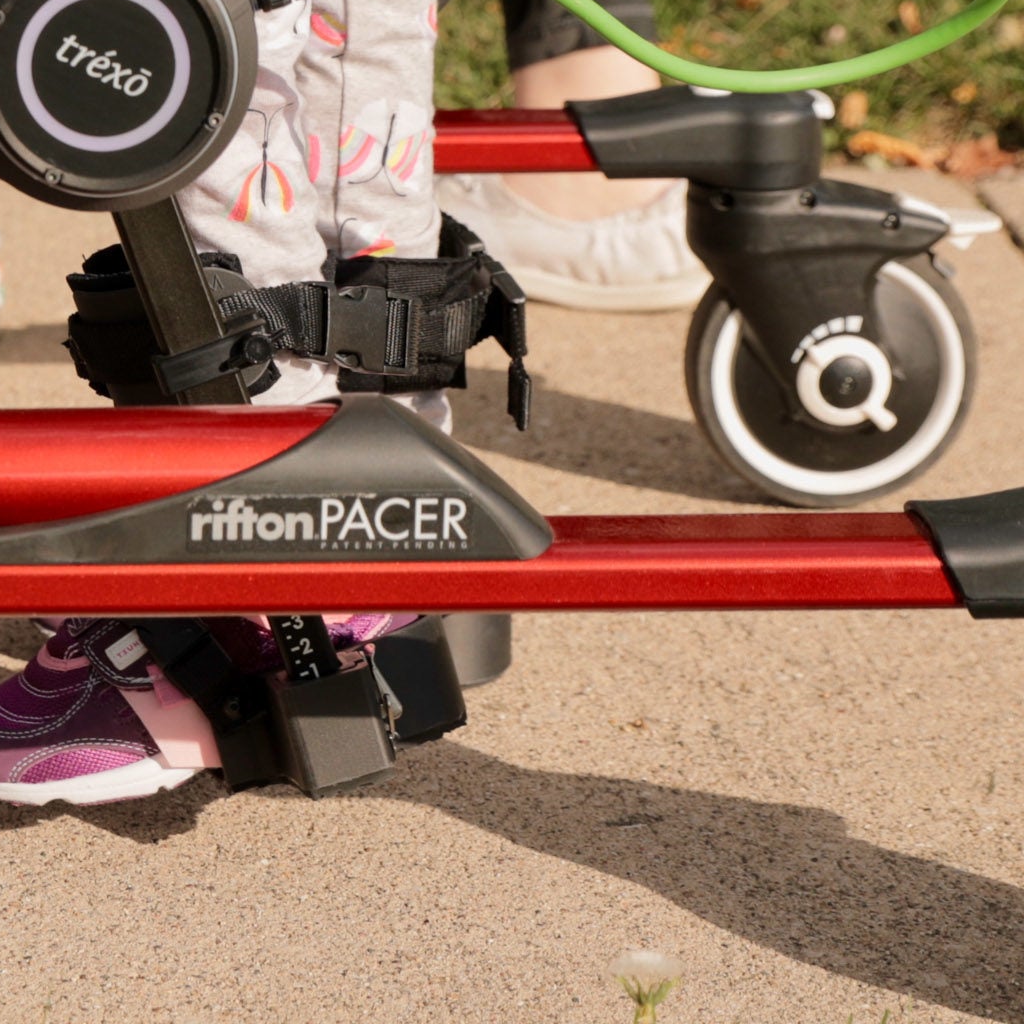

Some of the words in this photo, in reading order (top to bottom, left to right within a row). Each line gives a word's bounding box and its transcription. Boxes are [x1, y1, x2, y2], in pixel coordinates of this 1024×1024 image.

[191, 499, 314, 541] rifton
[320, 497, 468, 541] PACER
[320, 541, 384, 550] PATENT
[392, 541, 468, 550] PENDING
